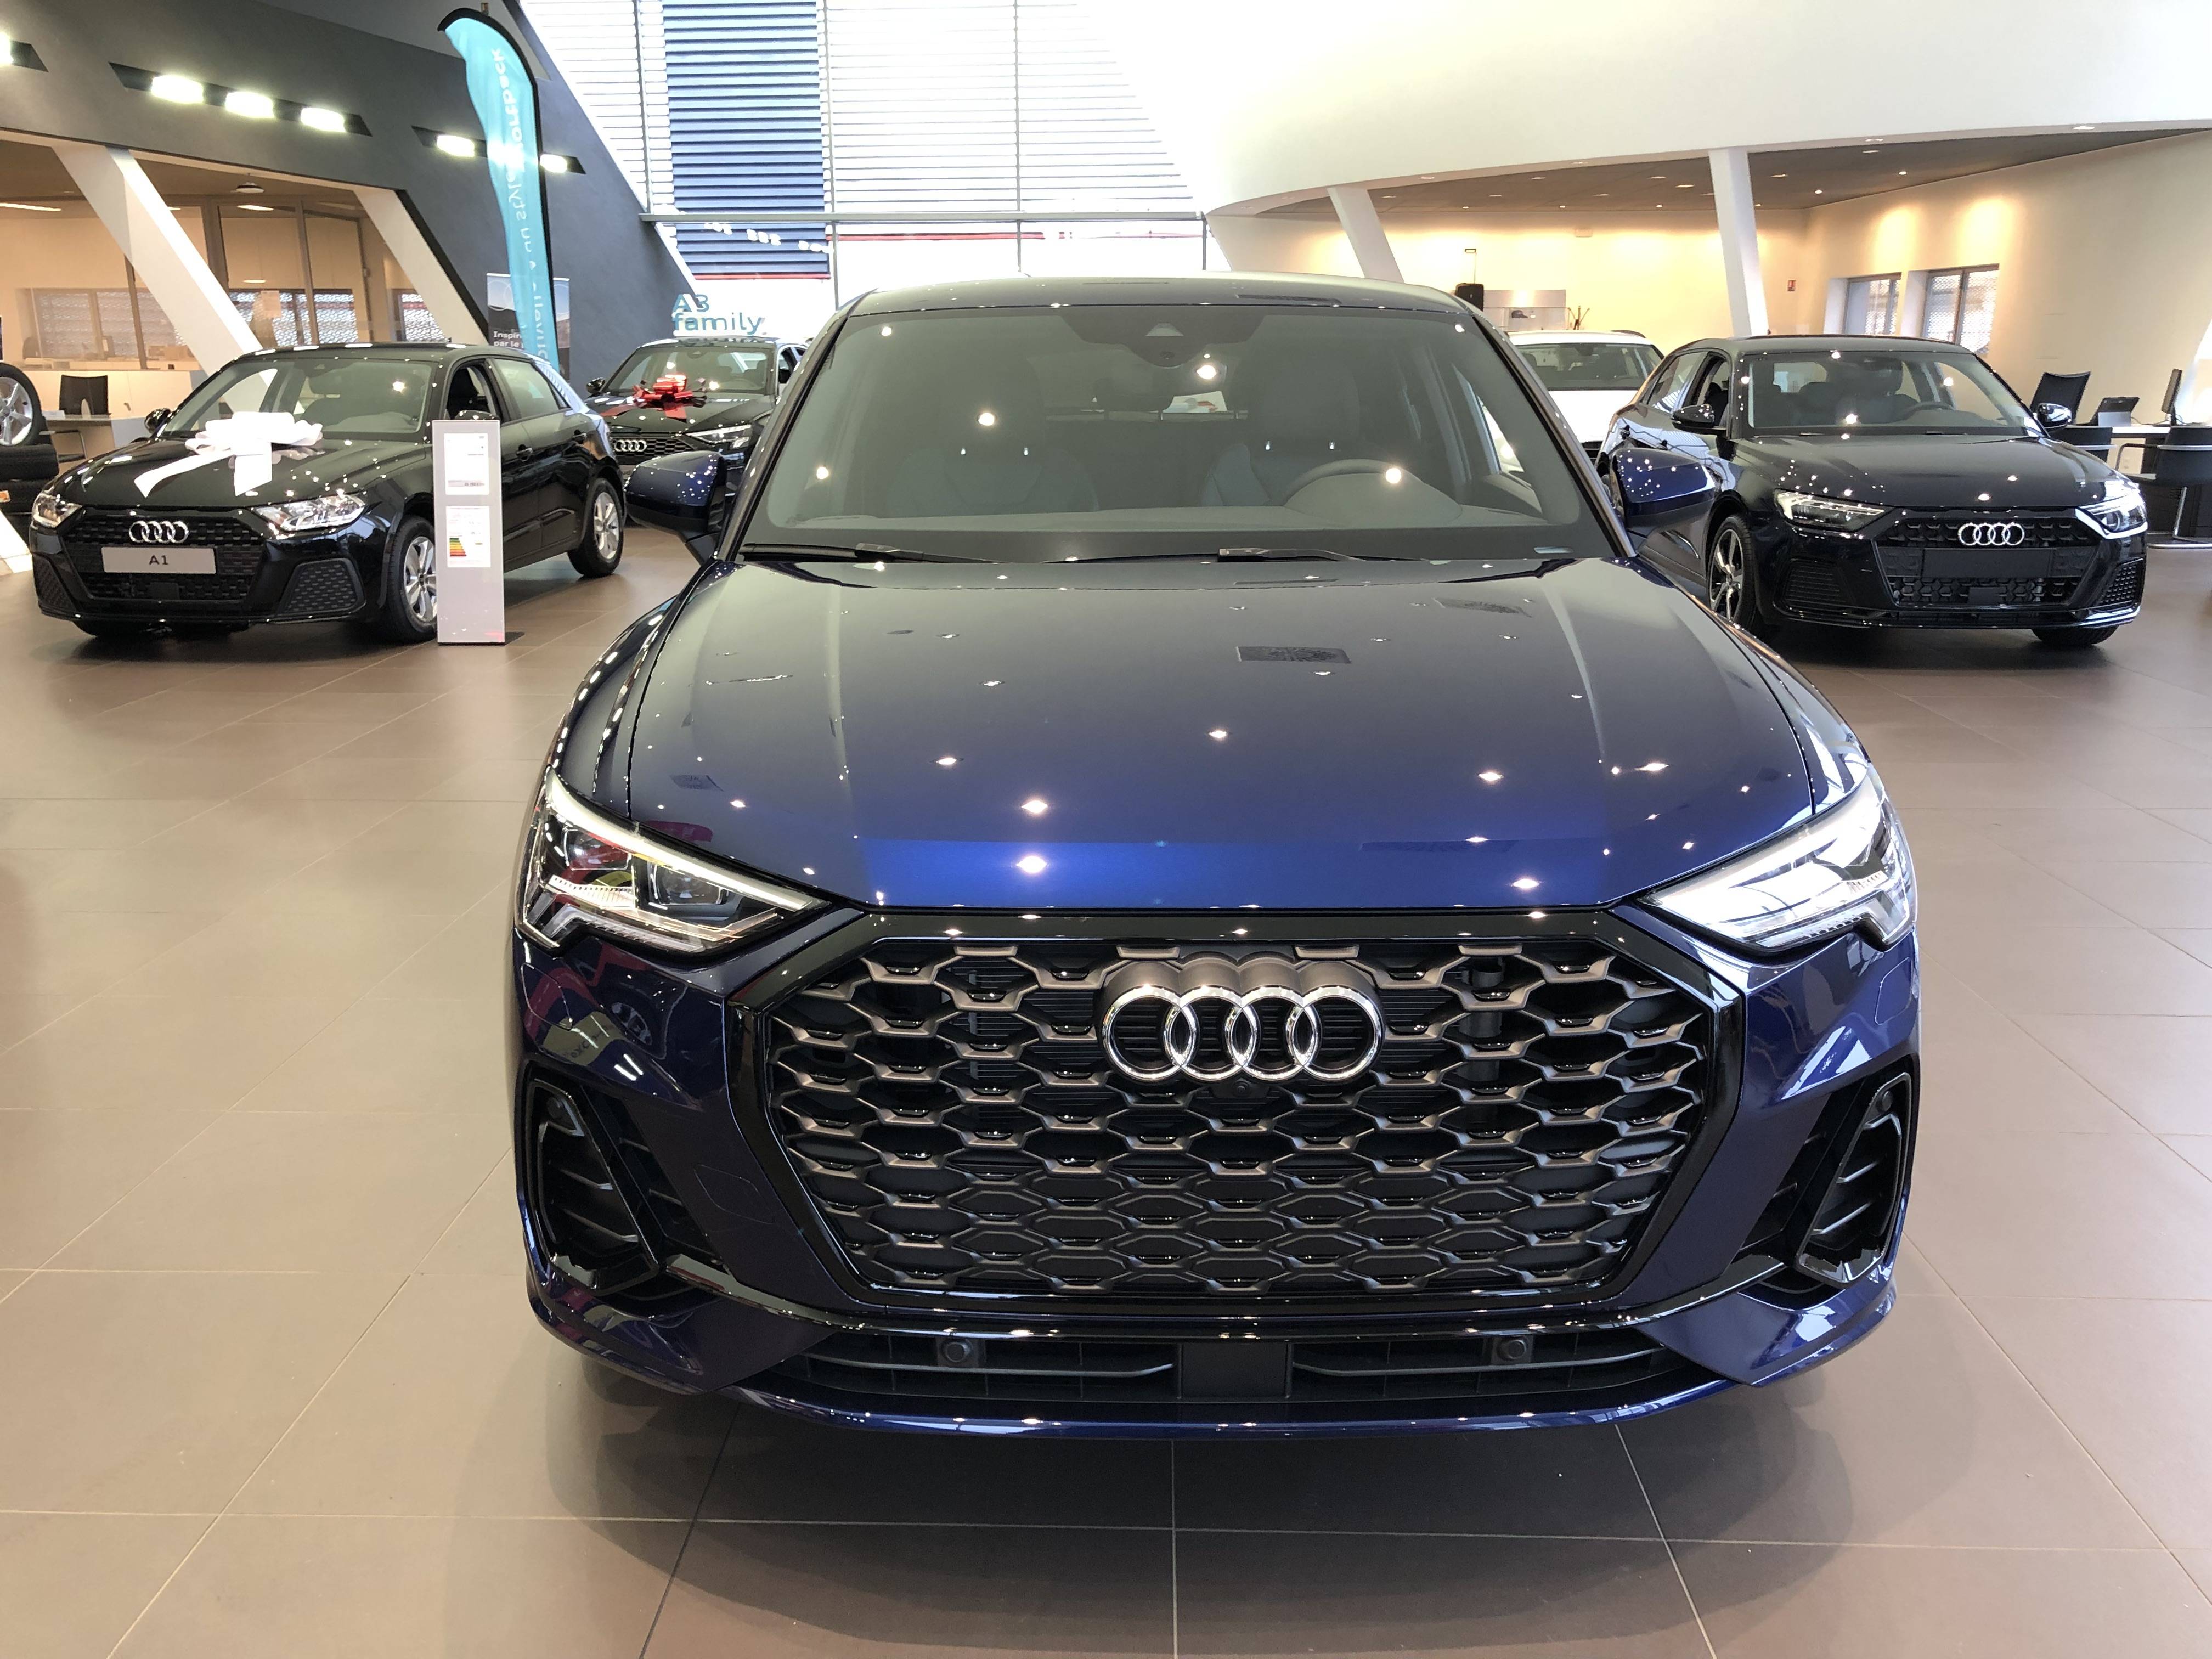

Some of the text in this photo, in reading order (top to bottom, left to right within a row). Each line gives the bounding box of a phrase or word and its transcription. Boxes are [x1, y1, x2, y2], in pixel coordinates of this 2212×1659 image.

[672, 294, 710, 312] A3
[672, 312, 762, 335] family
[493, 331, 522, 340] Inspir
[149, 555, 168, 565] A1
